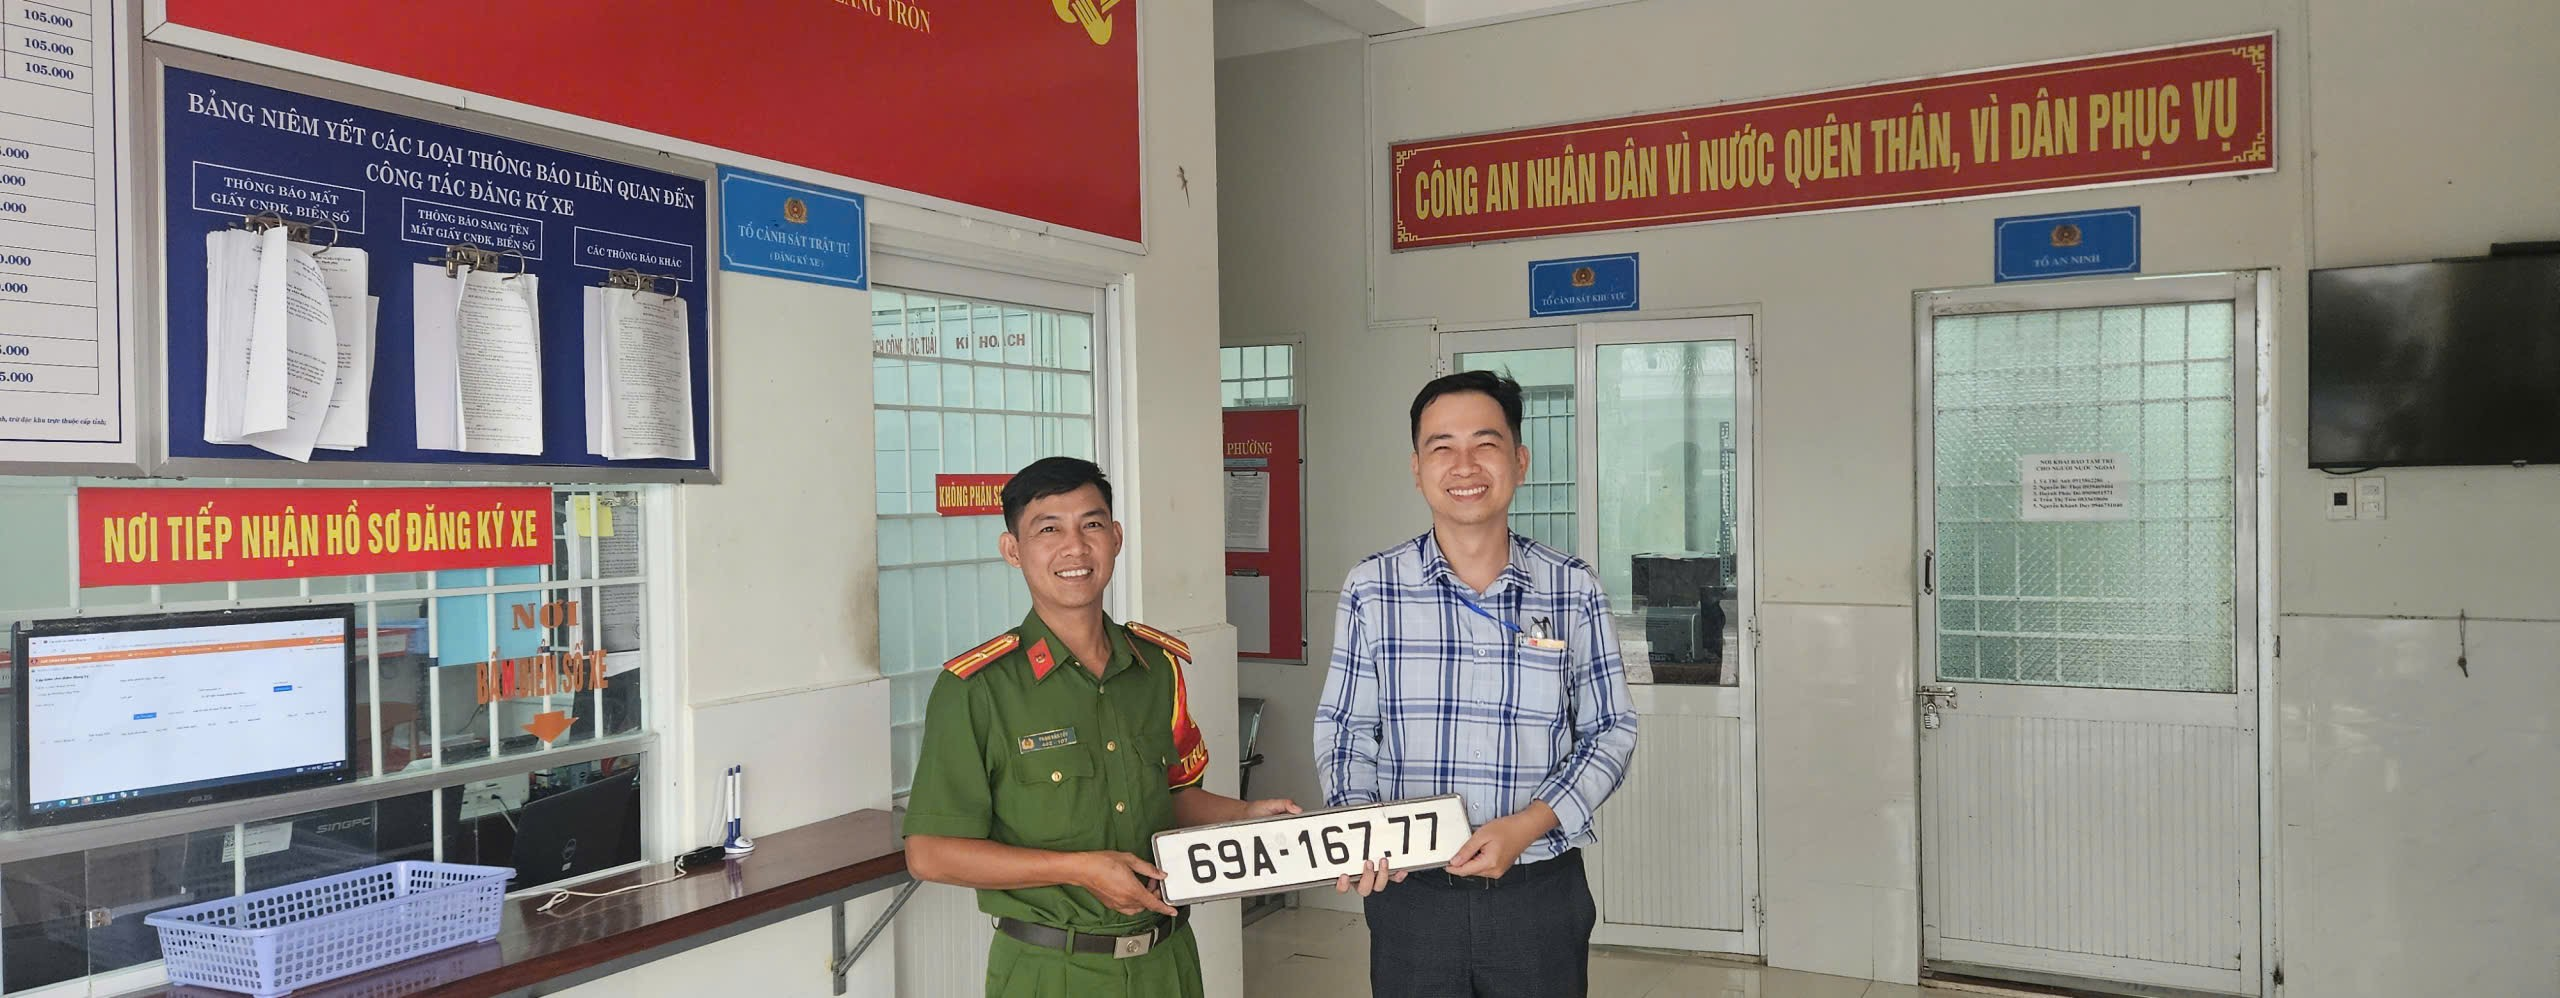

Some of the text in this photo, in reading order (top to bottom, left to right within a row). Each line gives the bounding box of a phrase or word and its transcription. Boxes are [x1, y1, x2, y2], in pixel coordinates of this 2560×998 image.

[24, 9, 73, 28] 105.000
[24, 37, 74, 56] 105.000
[25, 62, 74, 80] 105.000
[0, 146, 29, 160] .000
[188, 89, 694, 210] BẢNG NIÊM YẾT CÁC LOẠI THÔNG BÁO LIÊN QUAN ĐẾN
[1415, 77, 2238, 220] CÔNG AN NHÂN DÂN VÌ NƯỚC QUÊN THÂN, VÌ DÂN PHỤC VỤ
[224, 177, 339, 205] THÔNG BÁO MẤT
[366, 161, 574, 216] CÔNG TÁC ĐĂNG KÝ XE
[211, 192, 246, 207] GIẤY
[296, 203, 329, 220] BIỂN
[332, 210, 350, 224] SỐ
[418, 208, 529, 236] THÔNG BÁO SANG TÊN
[411, 223, 435, 236] MẤT
[436, 226, 461, 240] GIẤY
[497, 235, 520, 249] BIỂN
[522, 239, 535, 251] SỐ
[738, 221, 850, 257] TỔ CẢNH SÁT TRẬT TỰ
[587, 243, 682, 267] CÁC THÔNG BÁO KHÁC
[2052, 258, 2068, 266] AN
[2071, 254, 2100, 264] NINH
[0, 282, 28, 294] .000
[0, 345, 29, 356] .000
[1226, 439, 1272, 455] PHƯỜNG
[939, 481, 968, 507] KHÔNG
[969, 481, 992, 511] PHẬN
[104, 499, 537, 567] NƠI TIẾP NHẬN HỒ SƠ ĐĂNG KÝ XE
[511, 598, 580, 630] NƠI
[518, 639, 557, 698] BIỂN
[562, 640, 584, 693] SỐ
[588, 649, 609, 691] XE
[1188, 812, 1438, 884] 69A-167.77
